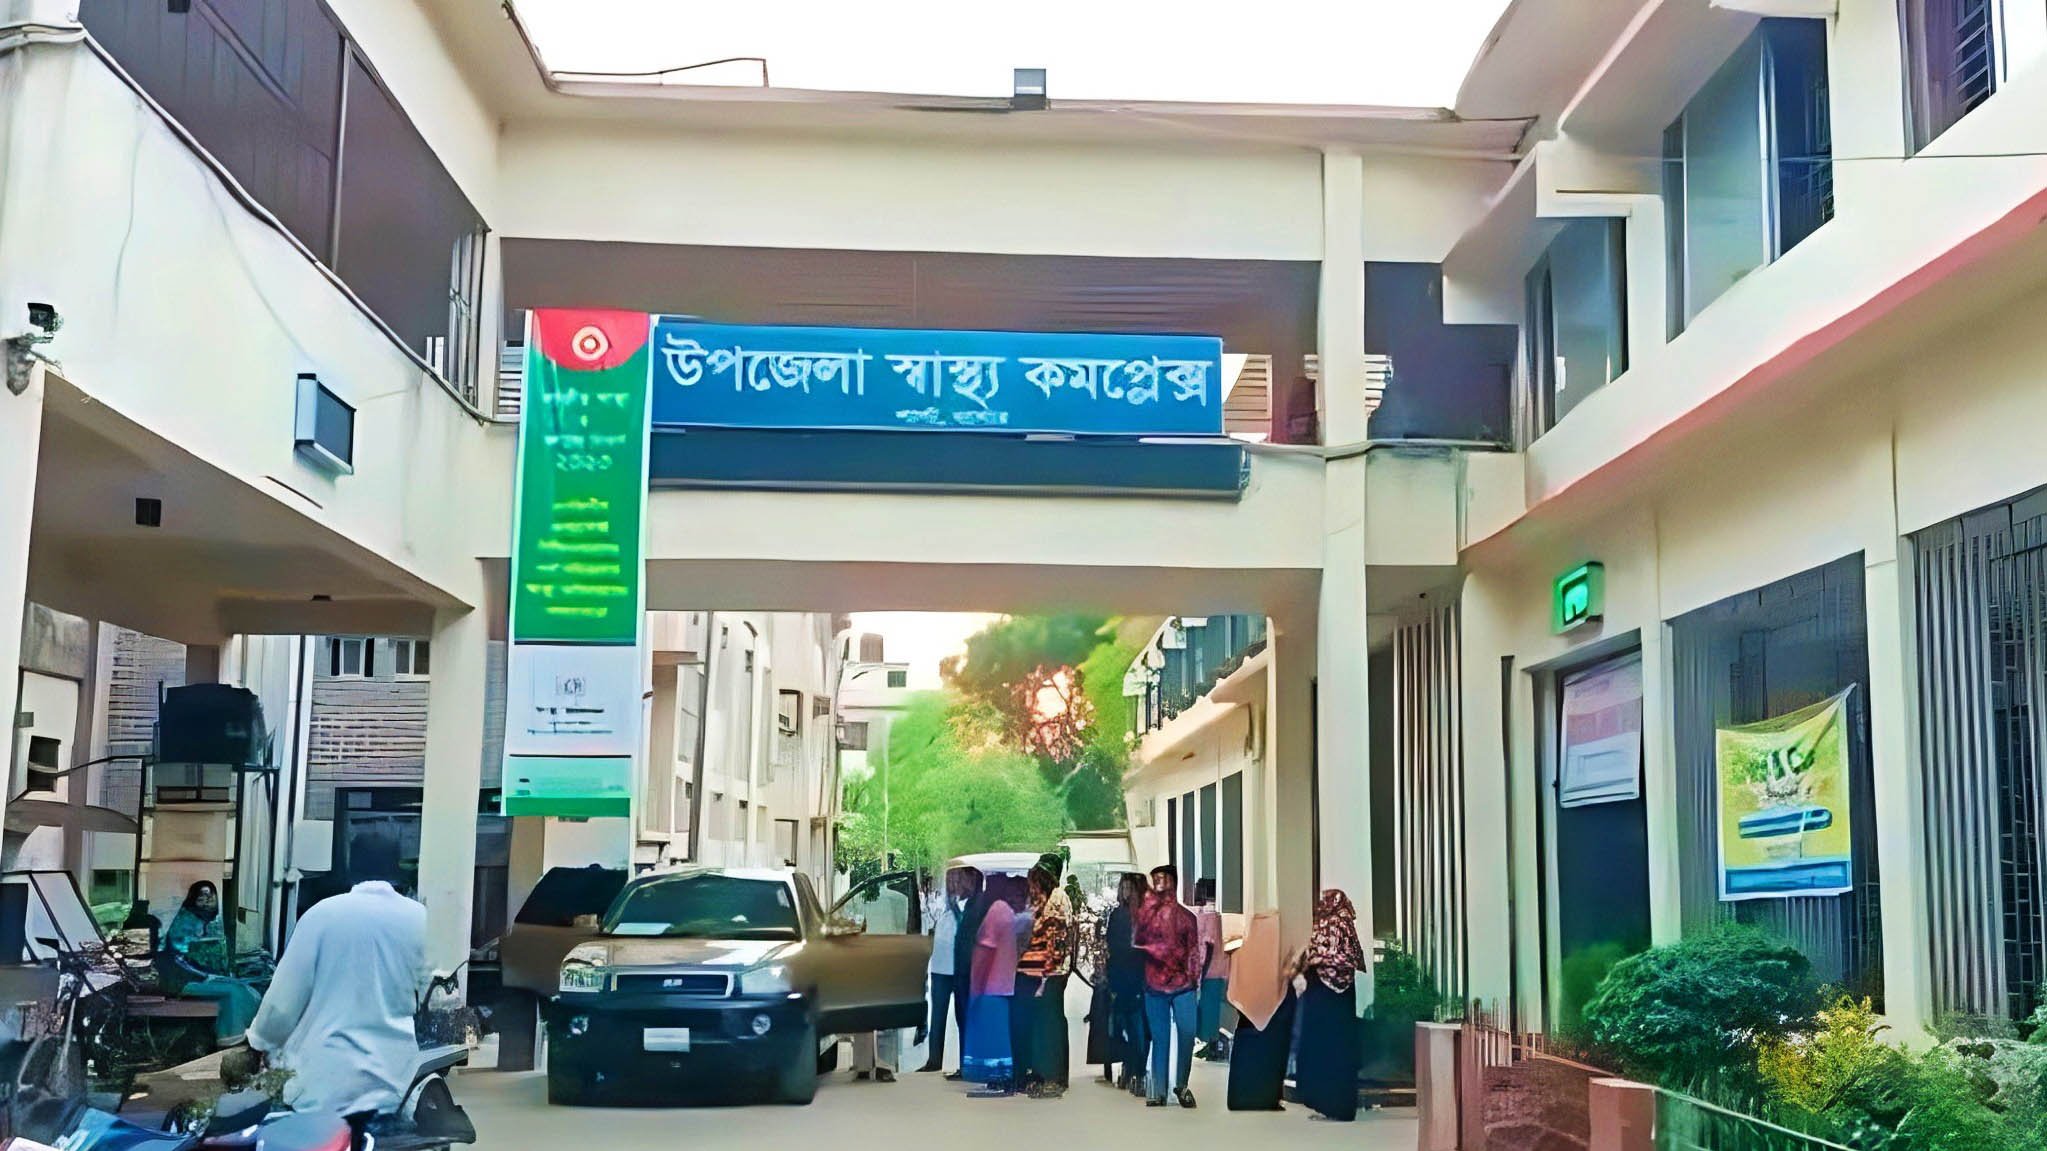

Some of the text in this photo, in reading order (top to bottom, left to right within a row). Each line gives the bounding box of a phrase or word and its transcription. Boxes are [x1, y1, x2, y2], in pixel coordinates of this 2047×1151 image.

[661, 333, 1214, 410] উপজেলা স্বাস্থ্য কমপ্লেক্স
